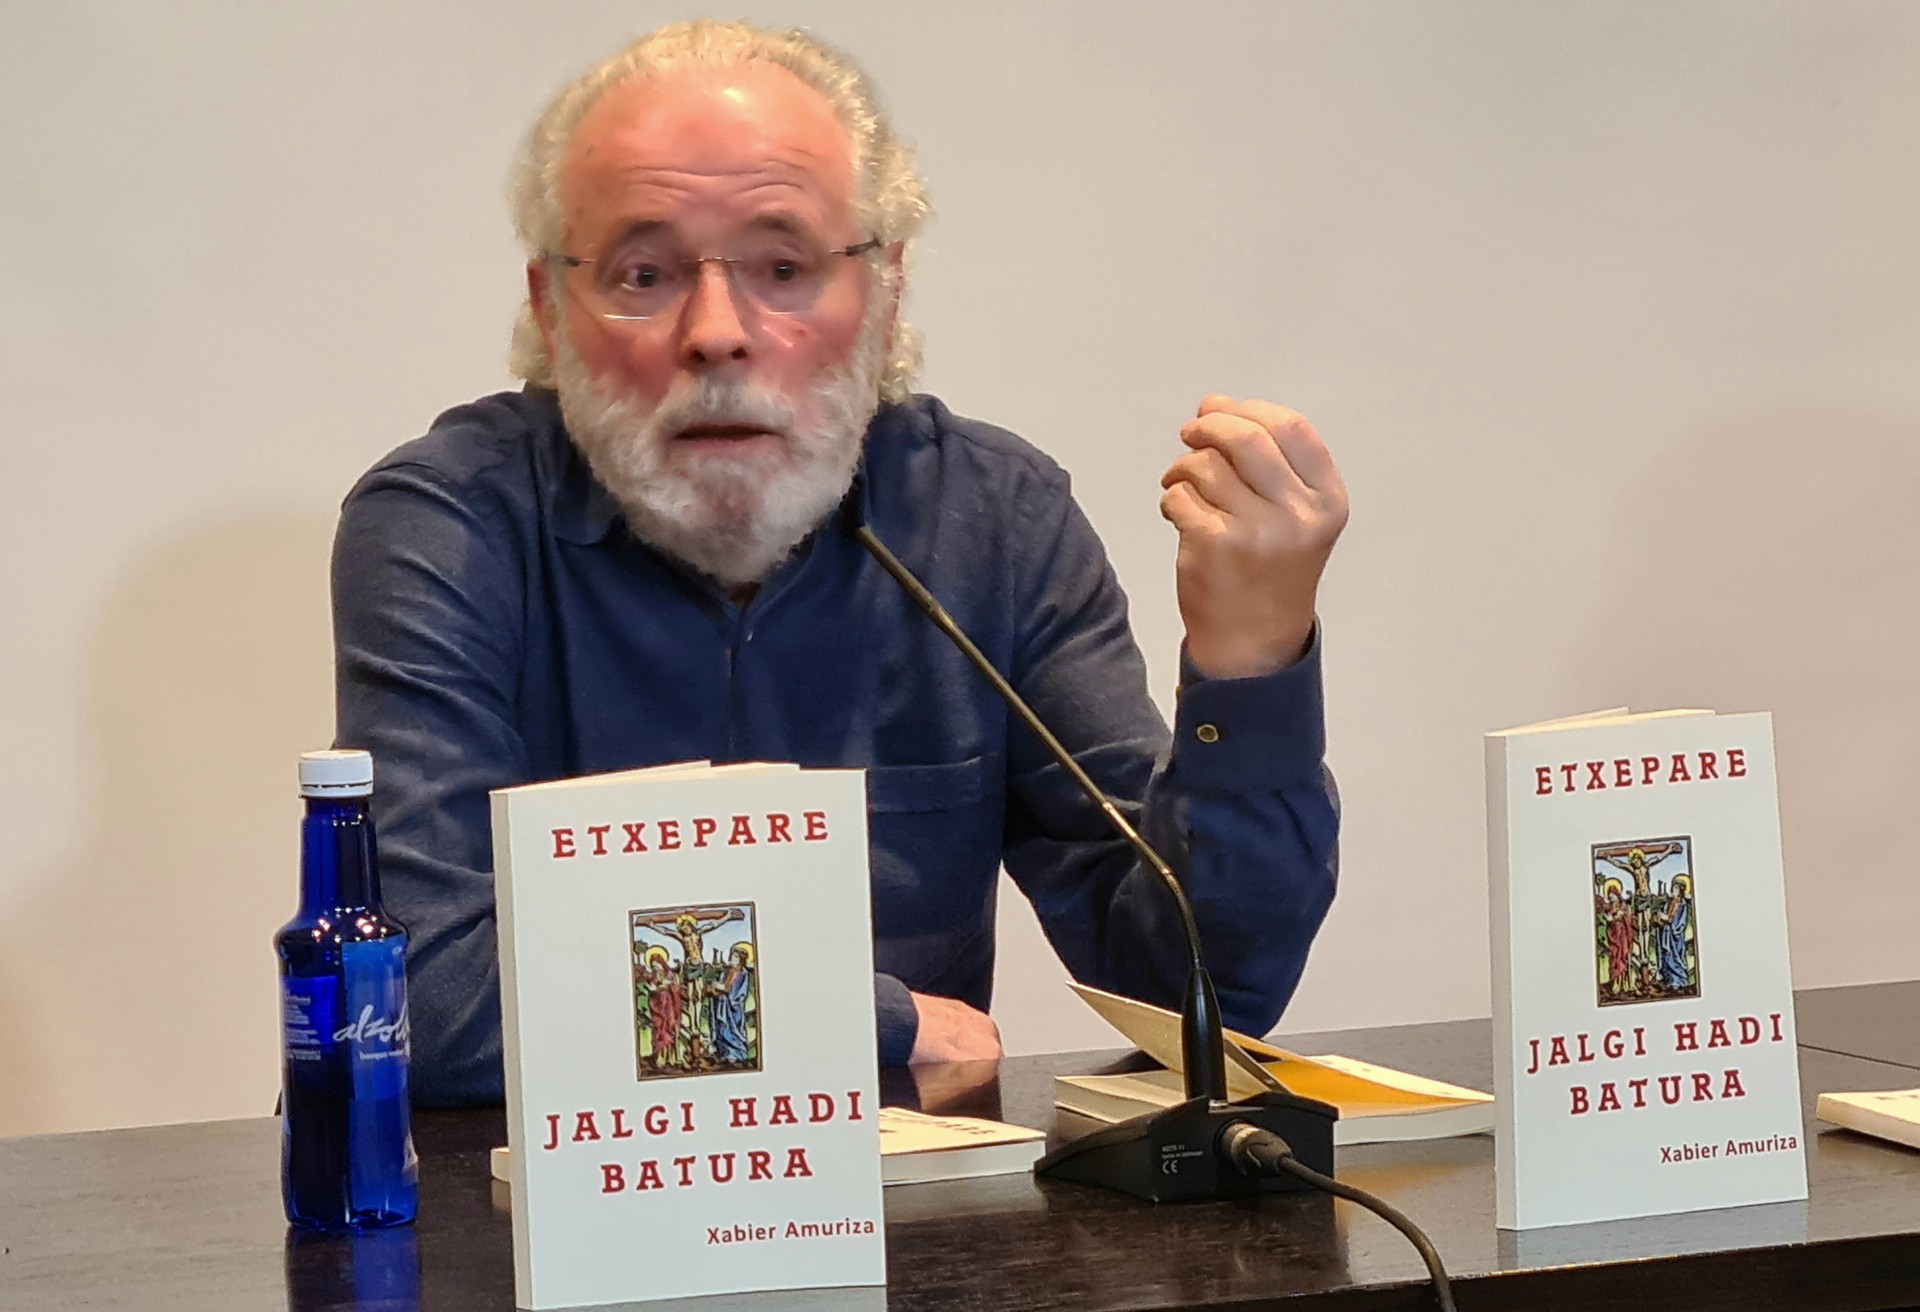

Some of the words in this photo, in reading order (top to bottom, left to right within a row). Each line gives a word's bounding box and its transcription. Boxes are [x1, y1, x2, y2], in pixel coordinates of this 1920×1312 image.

[1535, 748, 1747, 796] ETXEPARE
[552, 810, 829, 860] ETXEPARE
[1528, 1026, 1646, 1075] JALGI
[1673, 1013, 1784, 1052] HADI
[1569, 1068, 1747, 1117] BATURA
[543, 1101, 696, 1151] JALGI
[729, 1090, 864, 1129] HADI
[600, 1147, 814, 1195] BATURA
[1660, 1142, 1719, 1164] Xabier
[1725, 1134, 1798, 1157] Amuriza
[706, 1223, 777, 1245] Xabier
[784, 1217, 875, 1239] Amuriza
